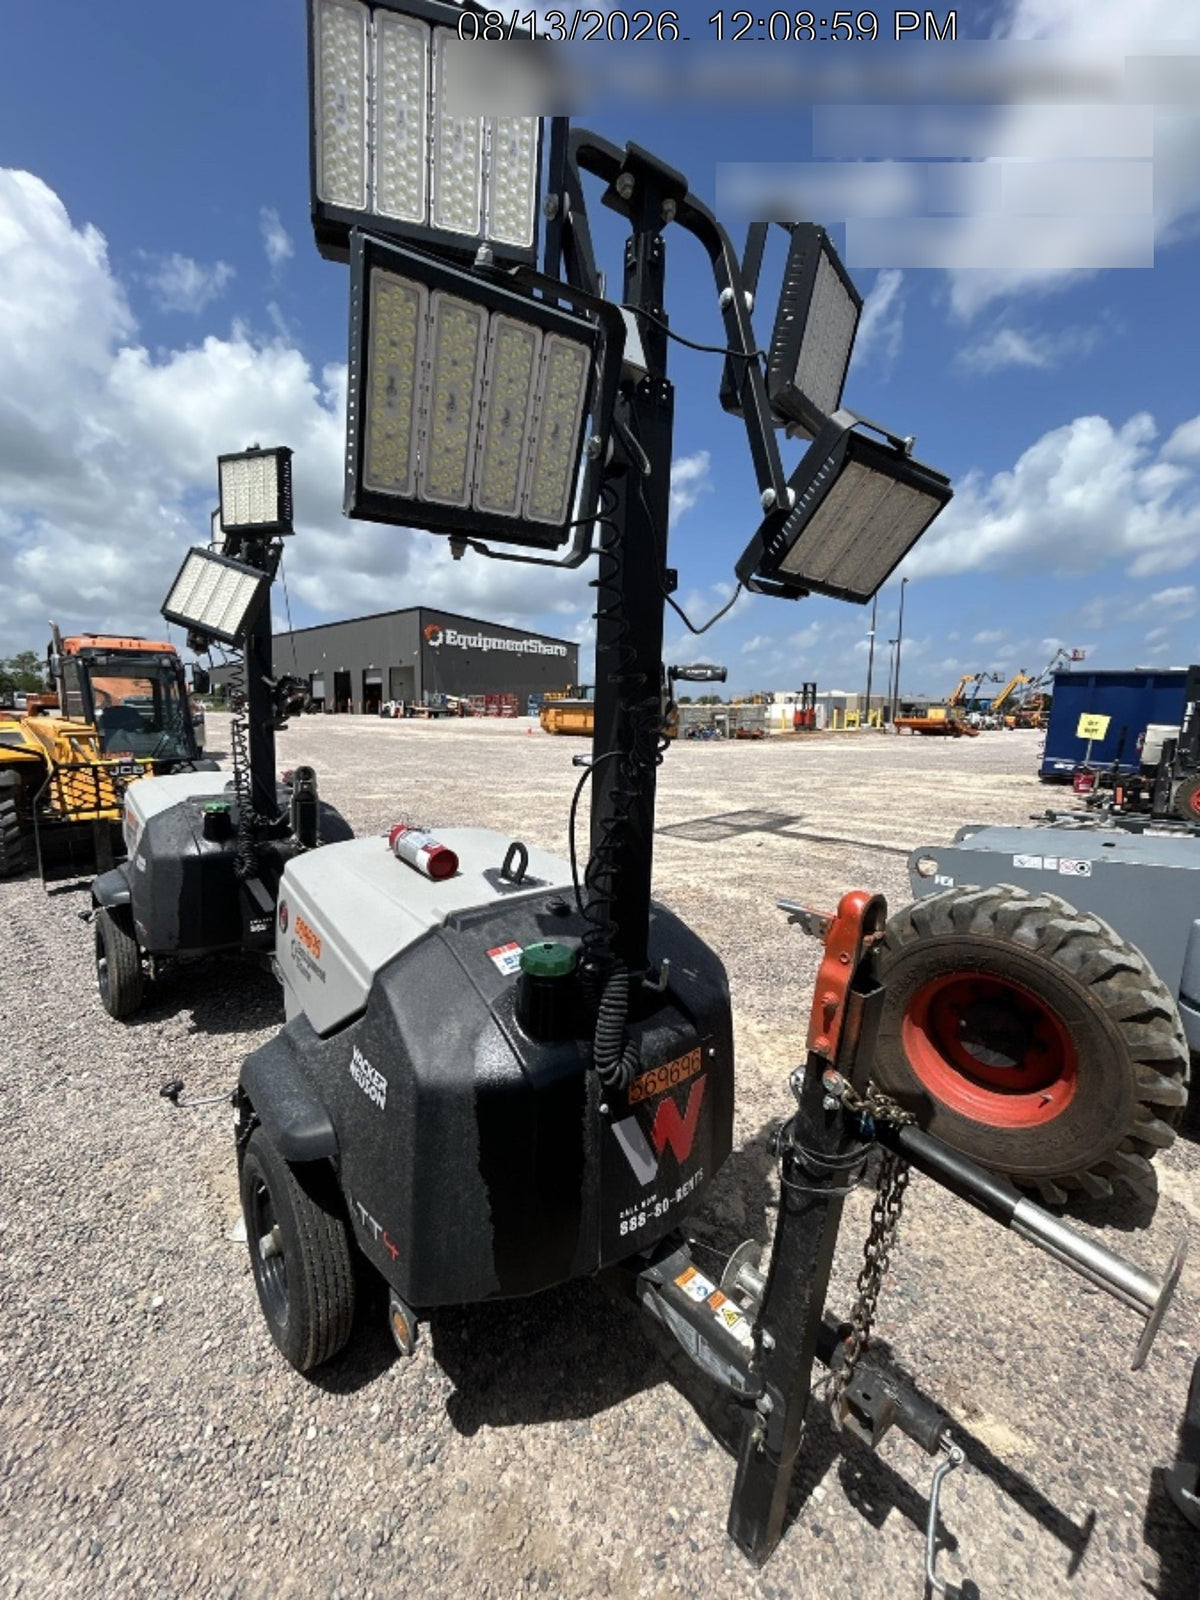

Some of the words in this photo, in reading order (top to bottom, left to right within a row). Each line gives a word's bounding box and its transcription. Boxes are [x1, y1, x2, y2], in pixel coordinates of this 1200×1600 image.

[445, 628, 568, 657] EquipmentShare
[109, 765, 145, 776] JCB
[353, 1045, 388, 1092] WACKER
[630, 1050, 700, 1101] 569696
